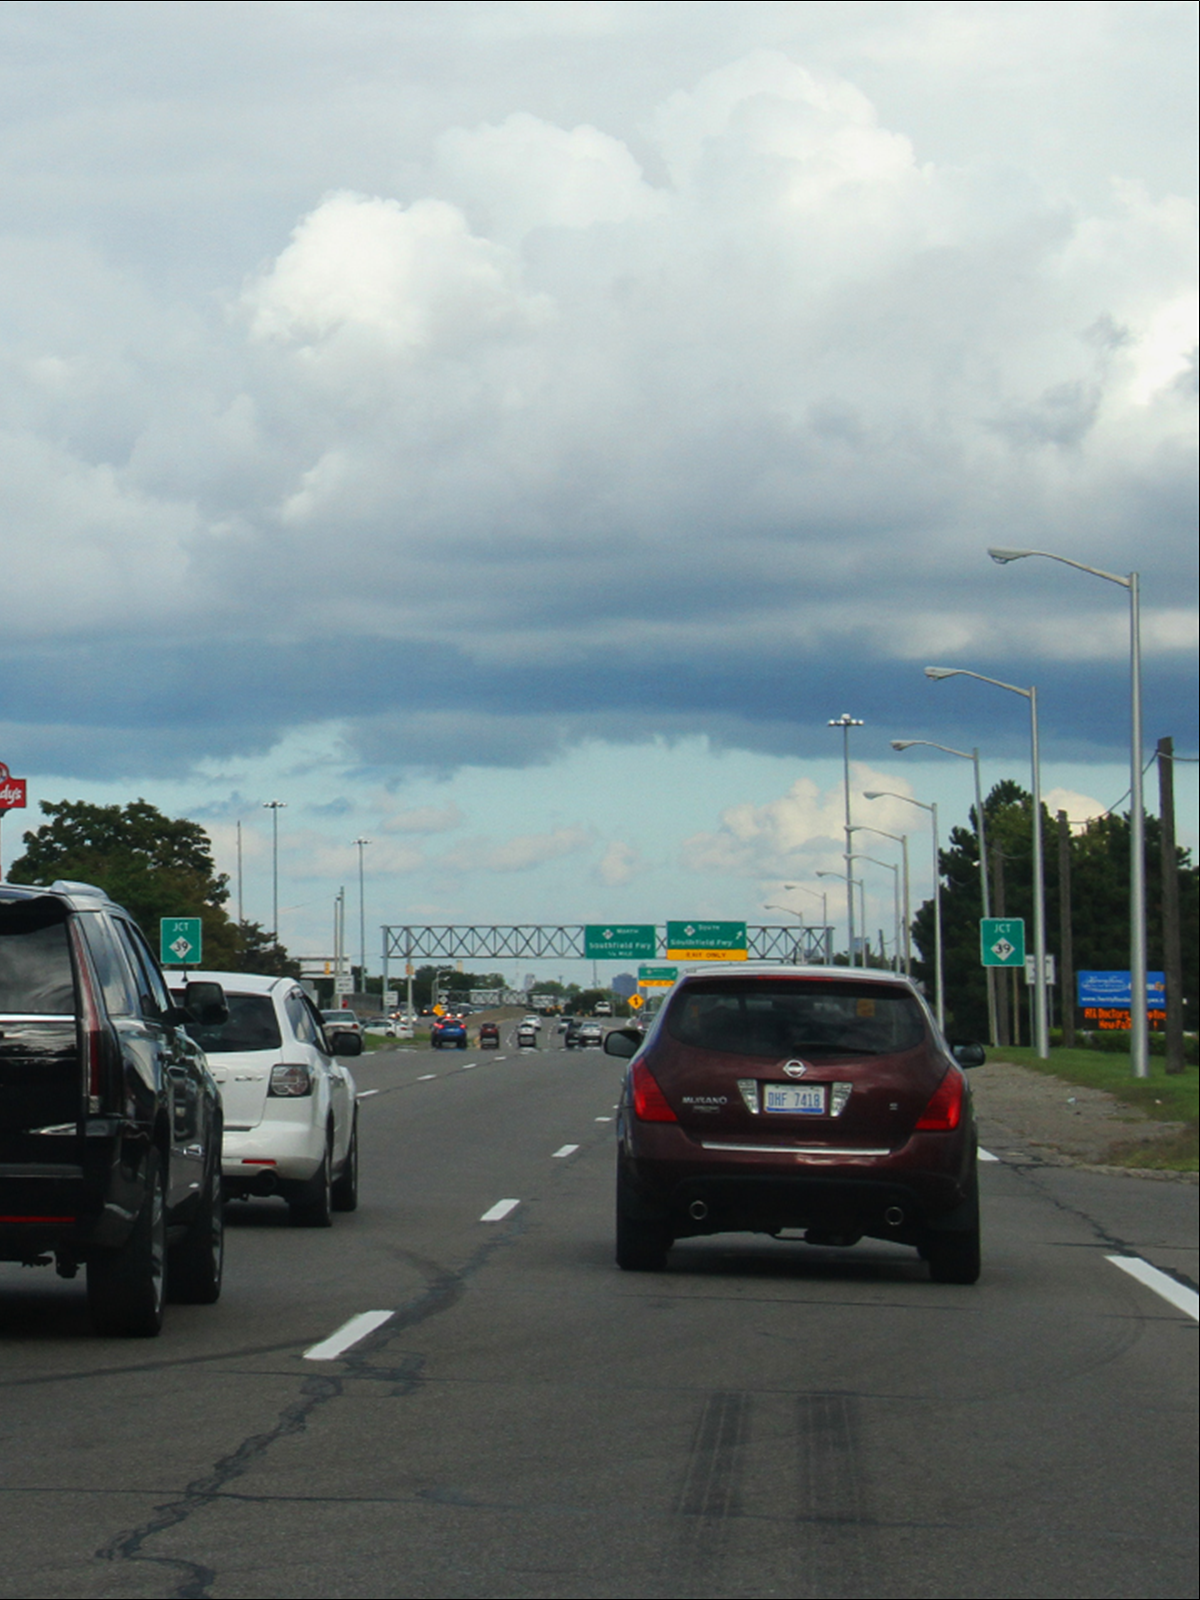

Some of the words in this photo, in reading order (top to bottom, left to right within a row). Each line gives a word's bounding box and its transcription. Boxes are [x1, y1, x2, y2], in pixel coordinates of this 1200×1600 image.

[172, 921, 189, 932] JCT
[994, 923, 1011, 933] JCT
[174, 940, 189, 952] 39
[995, 943, 1011, 954] 39
[682, 1096, 728, 1105] MURANO
